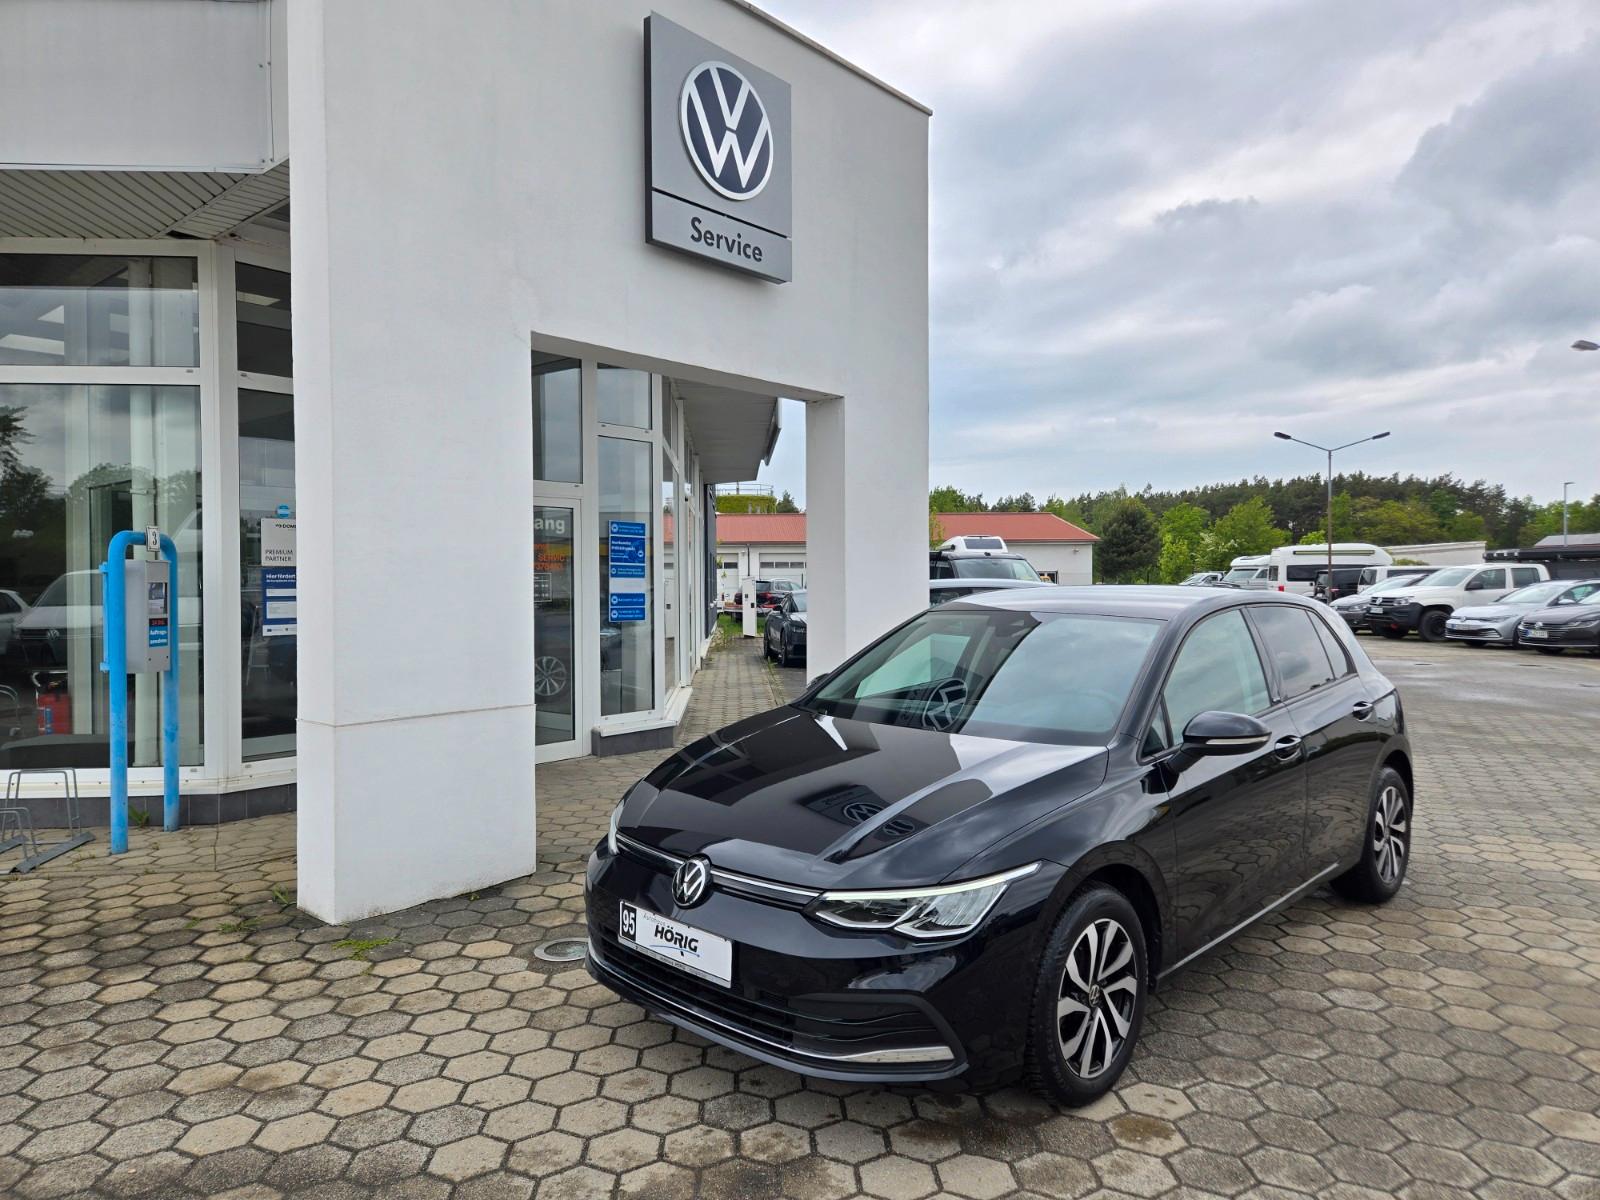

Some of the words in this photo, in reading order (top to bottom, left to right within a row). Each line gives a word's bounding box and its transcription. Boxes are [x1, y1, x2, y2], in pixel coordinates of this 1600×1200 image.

[680, 61, 774, 200] VW
[690, 216, 763, 262] Service
[152, 531, 158, 546] 3
[534, 518, 565, 534] ang
[622, 909, 636, 936] 95
[655, 925, 699, 957] HÖRIG
